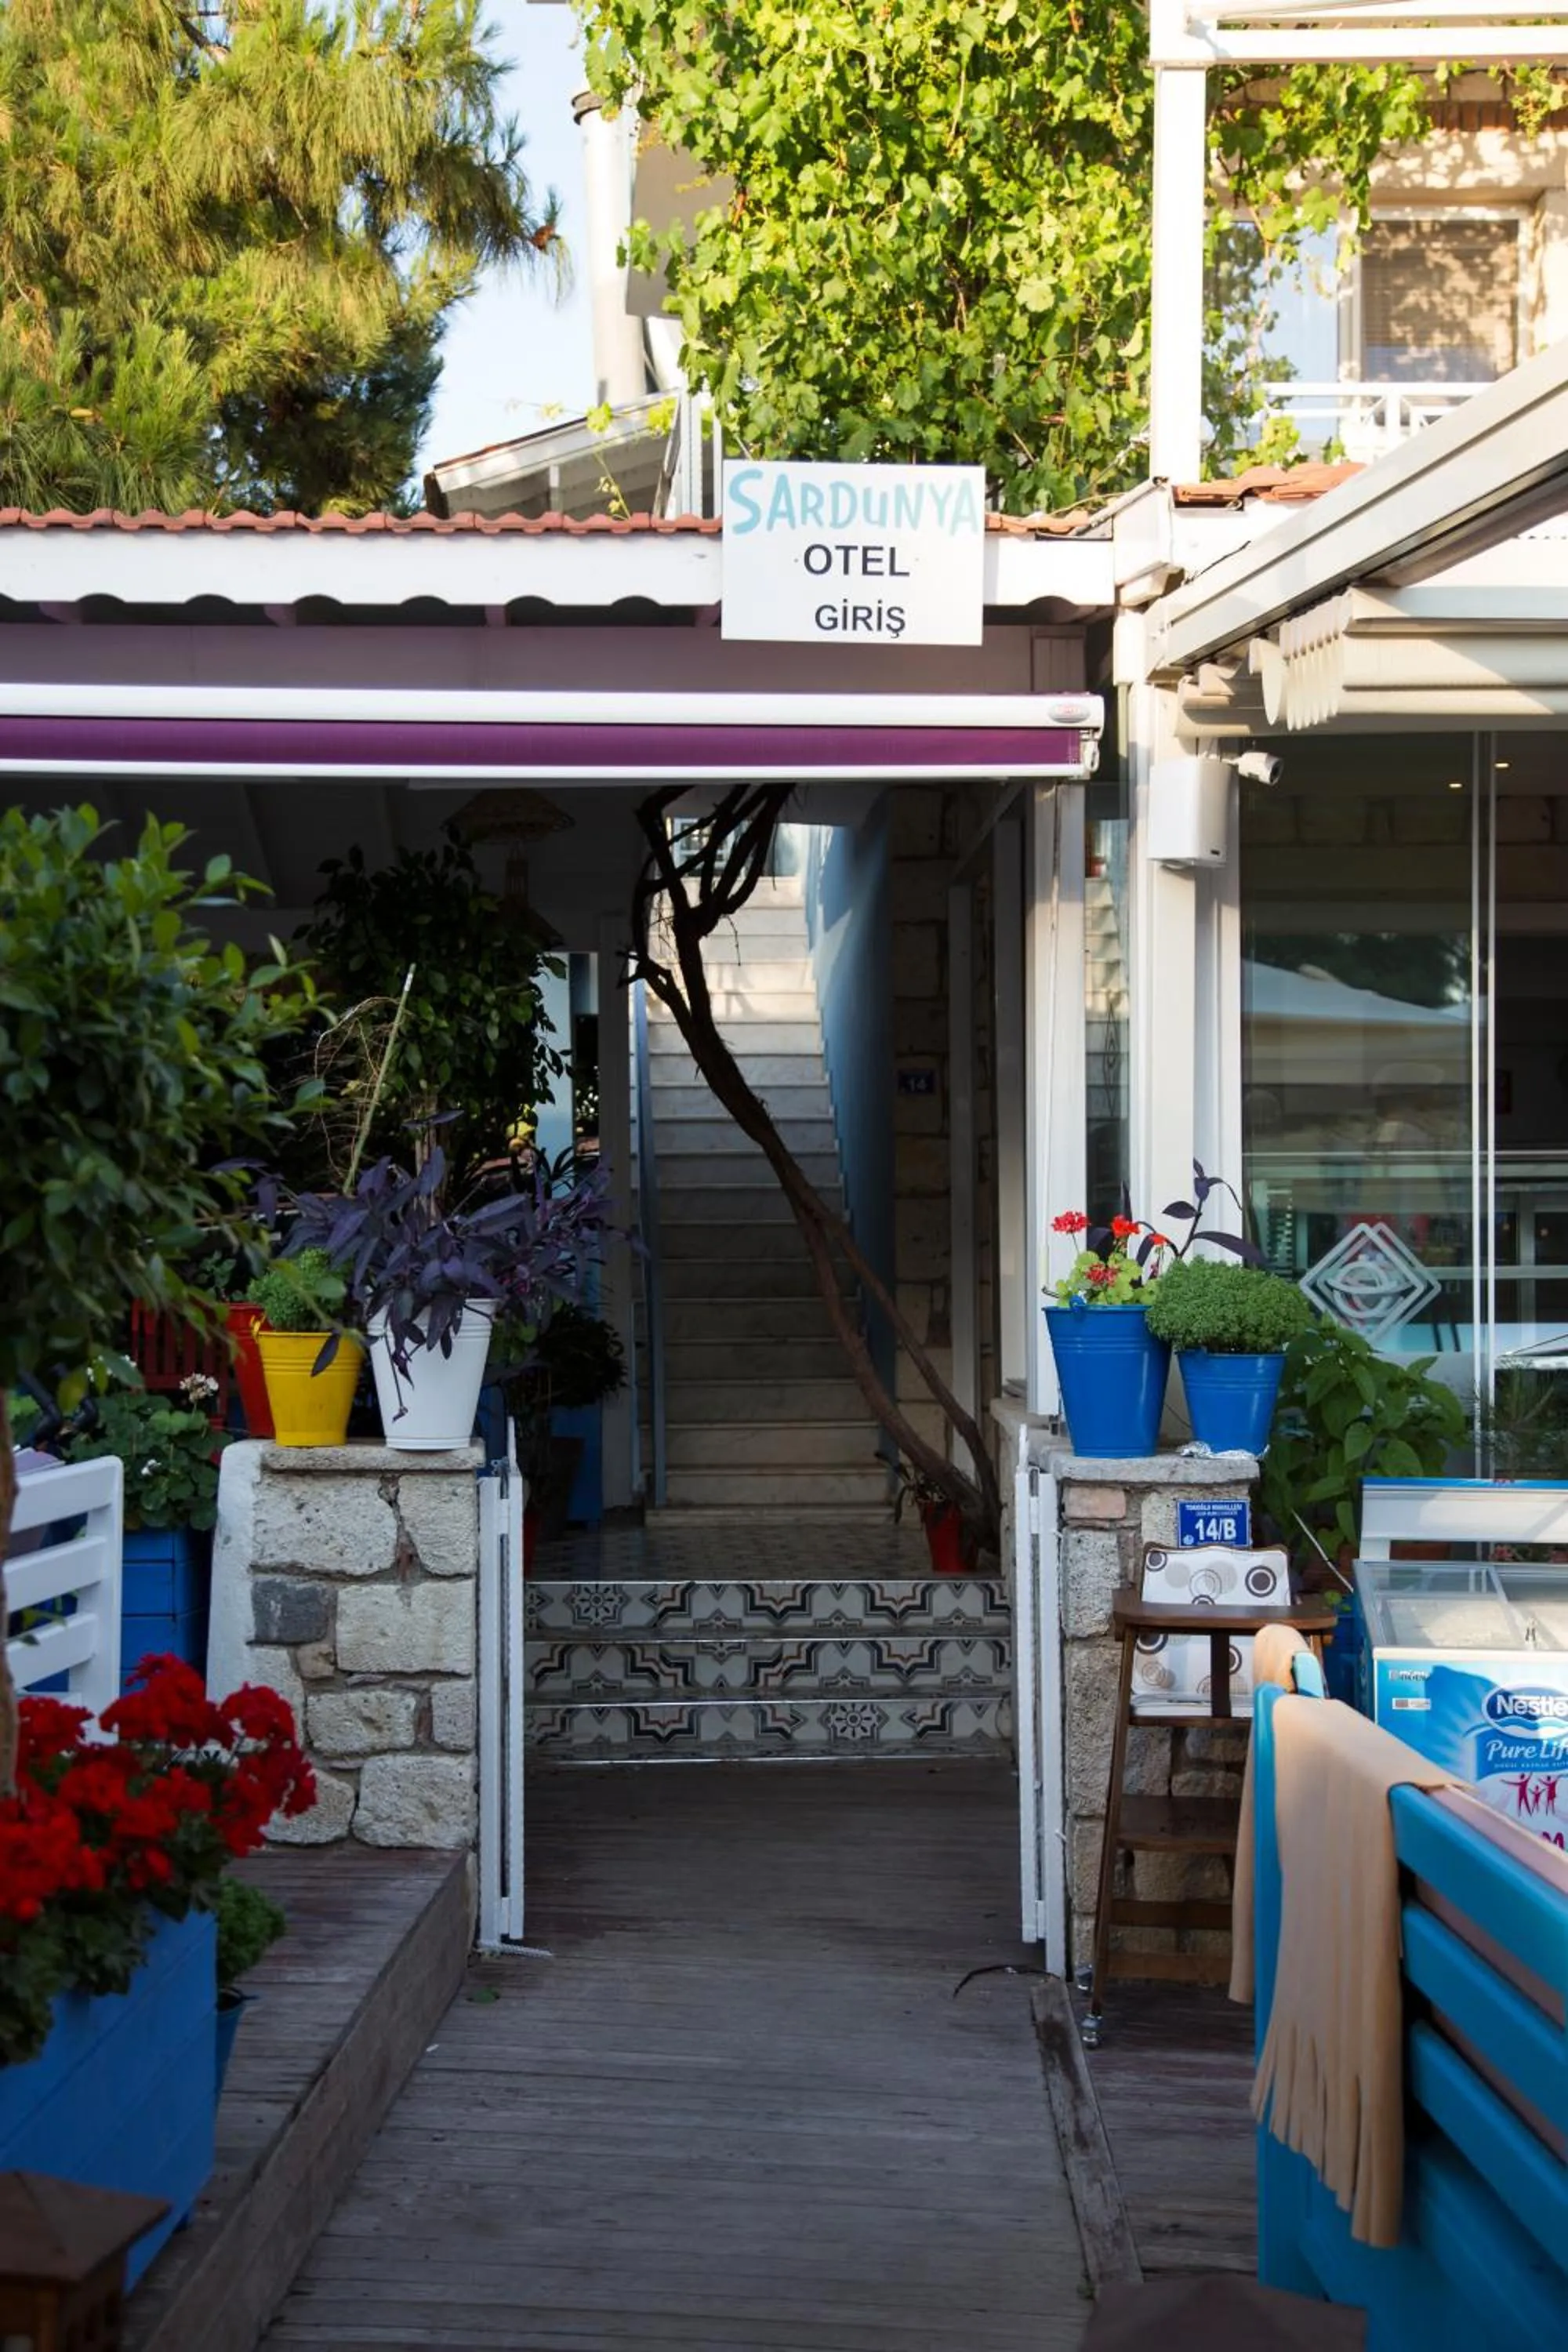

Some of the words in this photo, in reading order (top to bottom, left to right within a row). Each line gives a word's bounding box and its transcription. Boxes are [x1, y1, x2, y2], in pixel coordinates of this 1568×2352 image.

[804, 544, 910, 576] OTEL
[815, 598, 906, 639] GİRİŞ
[1195, 1518, 1236, 1541] 14/B
[1486, 1739, 1537, 1761] Pure
